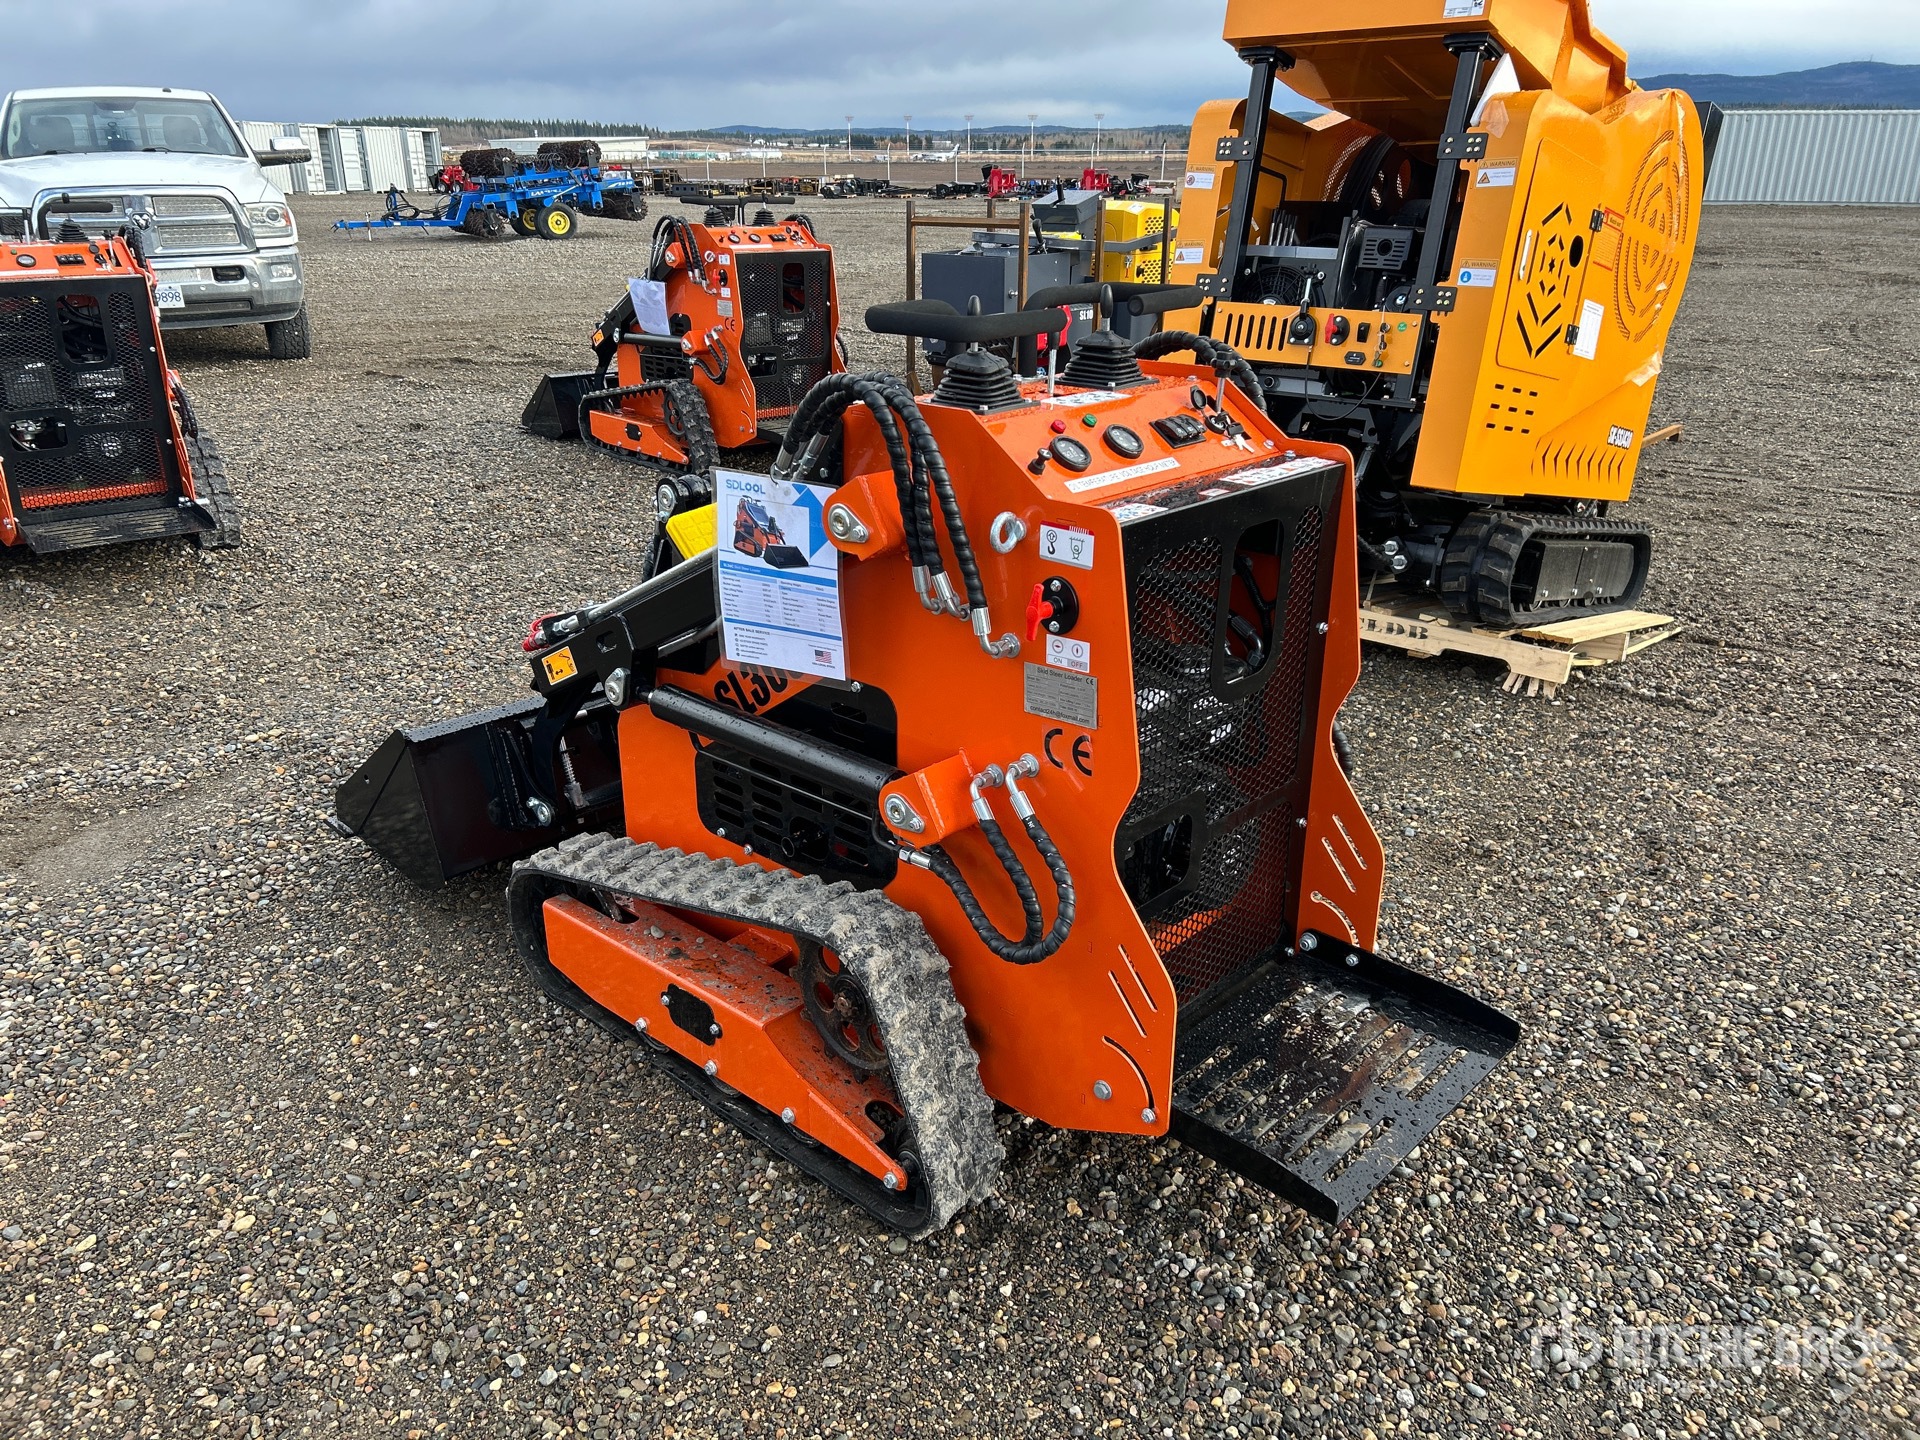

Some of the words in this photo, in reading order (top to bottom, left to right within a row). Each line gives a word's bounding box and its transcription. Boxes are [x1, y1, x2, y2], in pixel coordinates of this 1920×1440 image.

[726, 479, 766, 494] SDLOOL
[1053, 656, 1063, 665] ON
[1071, 659, 1083, 668] OFF
[1037, 666, 1049, 676] Skid
[1050, 669, 1063, 680] Steer
[1064, 672, 1083, 683] Loader
[1044, 728, 1093, 777] CE
